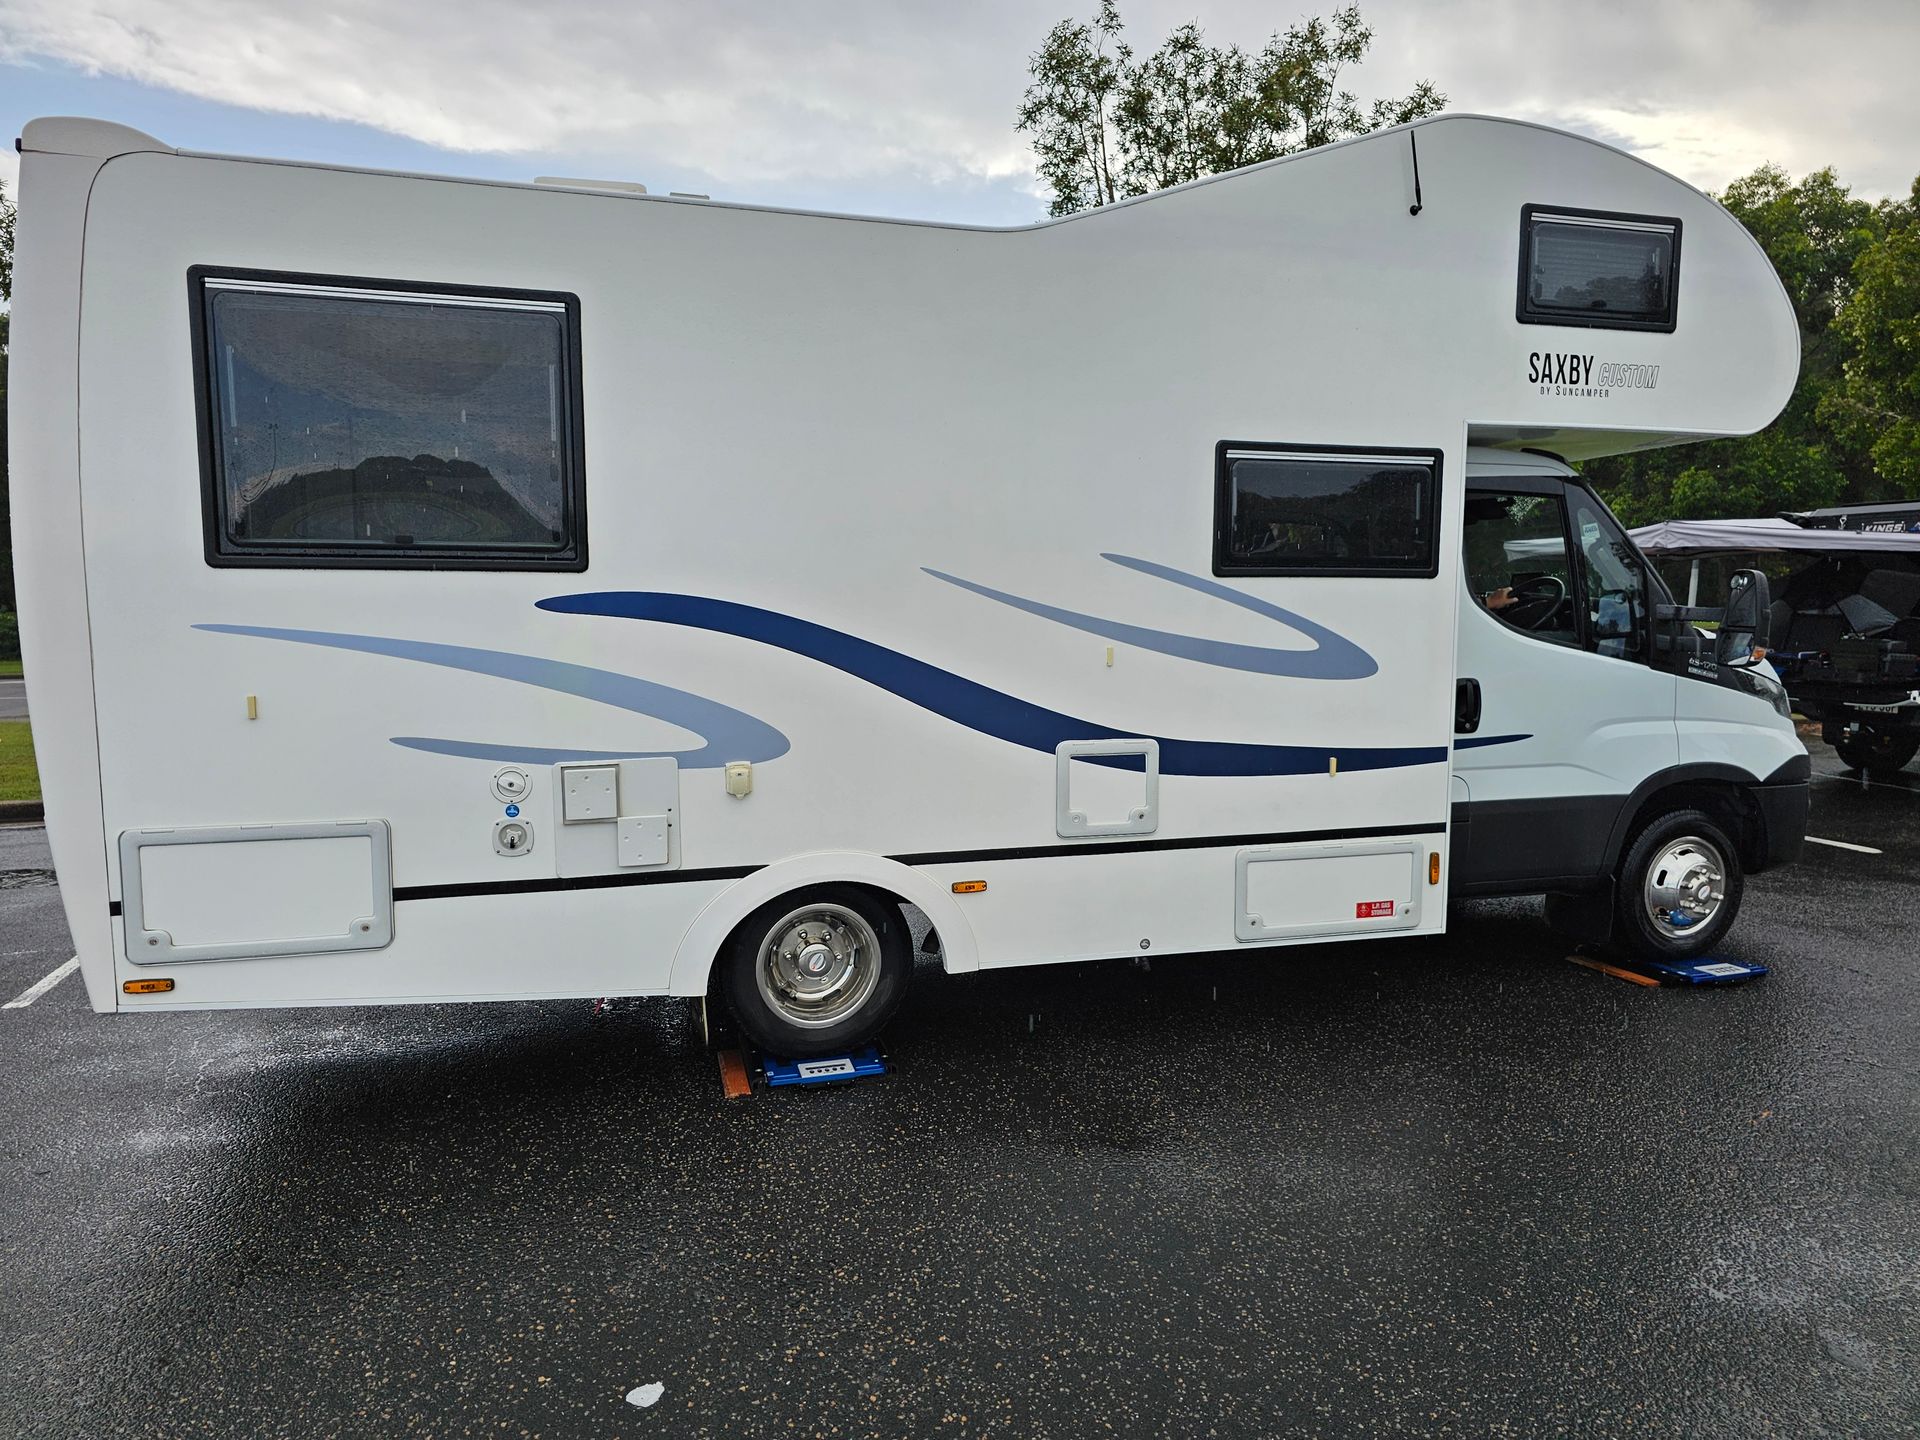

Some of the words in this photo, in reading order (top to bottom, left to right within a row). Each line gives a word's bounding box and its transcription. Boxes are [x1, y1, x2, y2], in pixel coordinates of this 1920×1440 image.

[1528, 352, 1594, 385] SAXBY
[1598, 363, 1660, 389] CUSTOM
[1540, 386, 1551, 395] BY
[1865, 523, 1902, 532] KINGS
